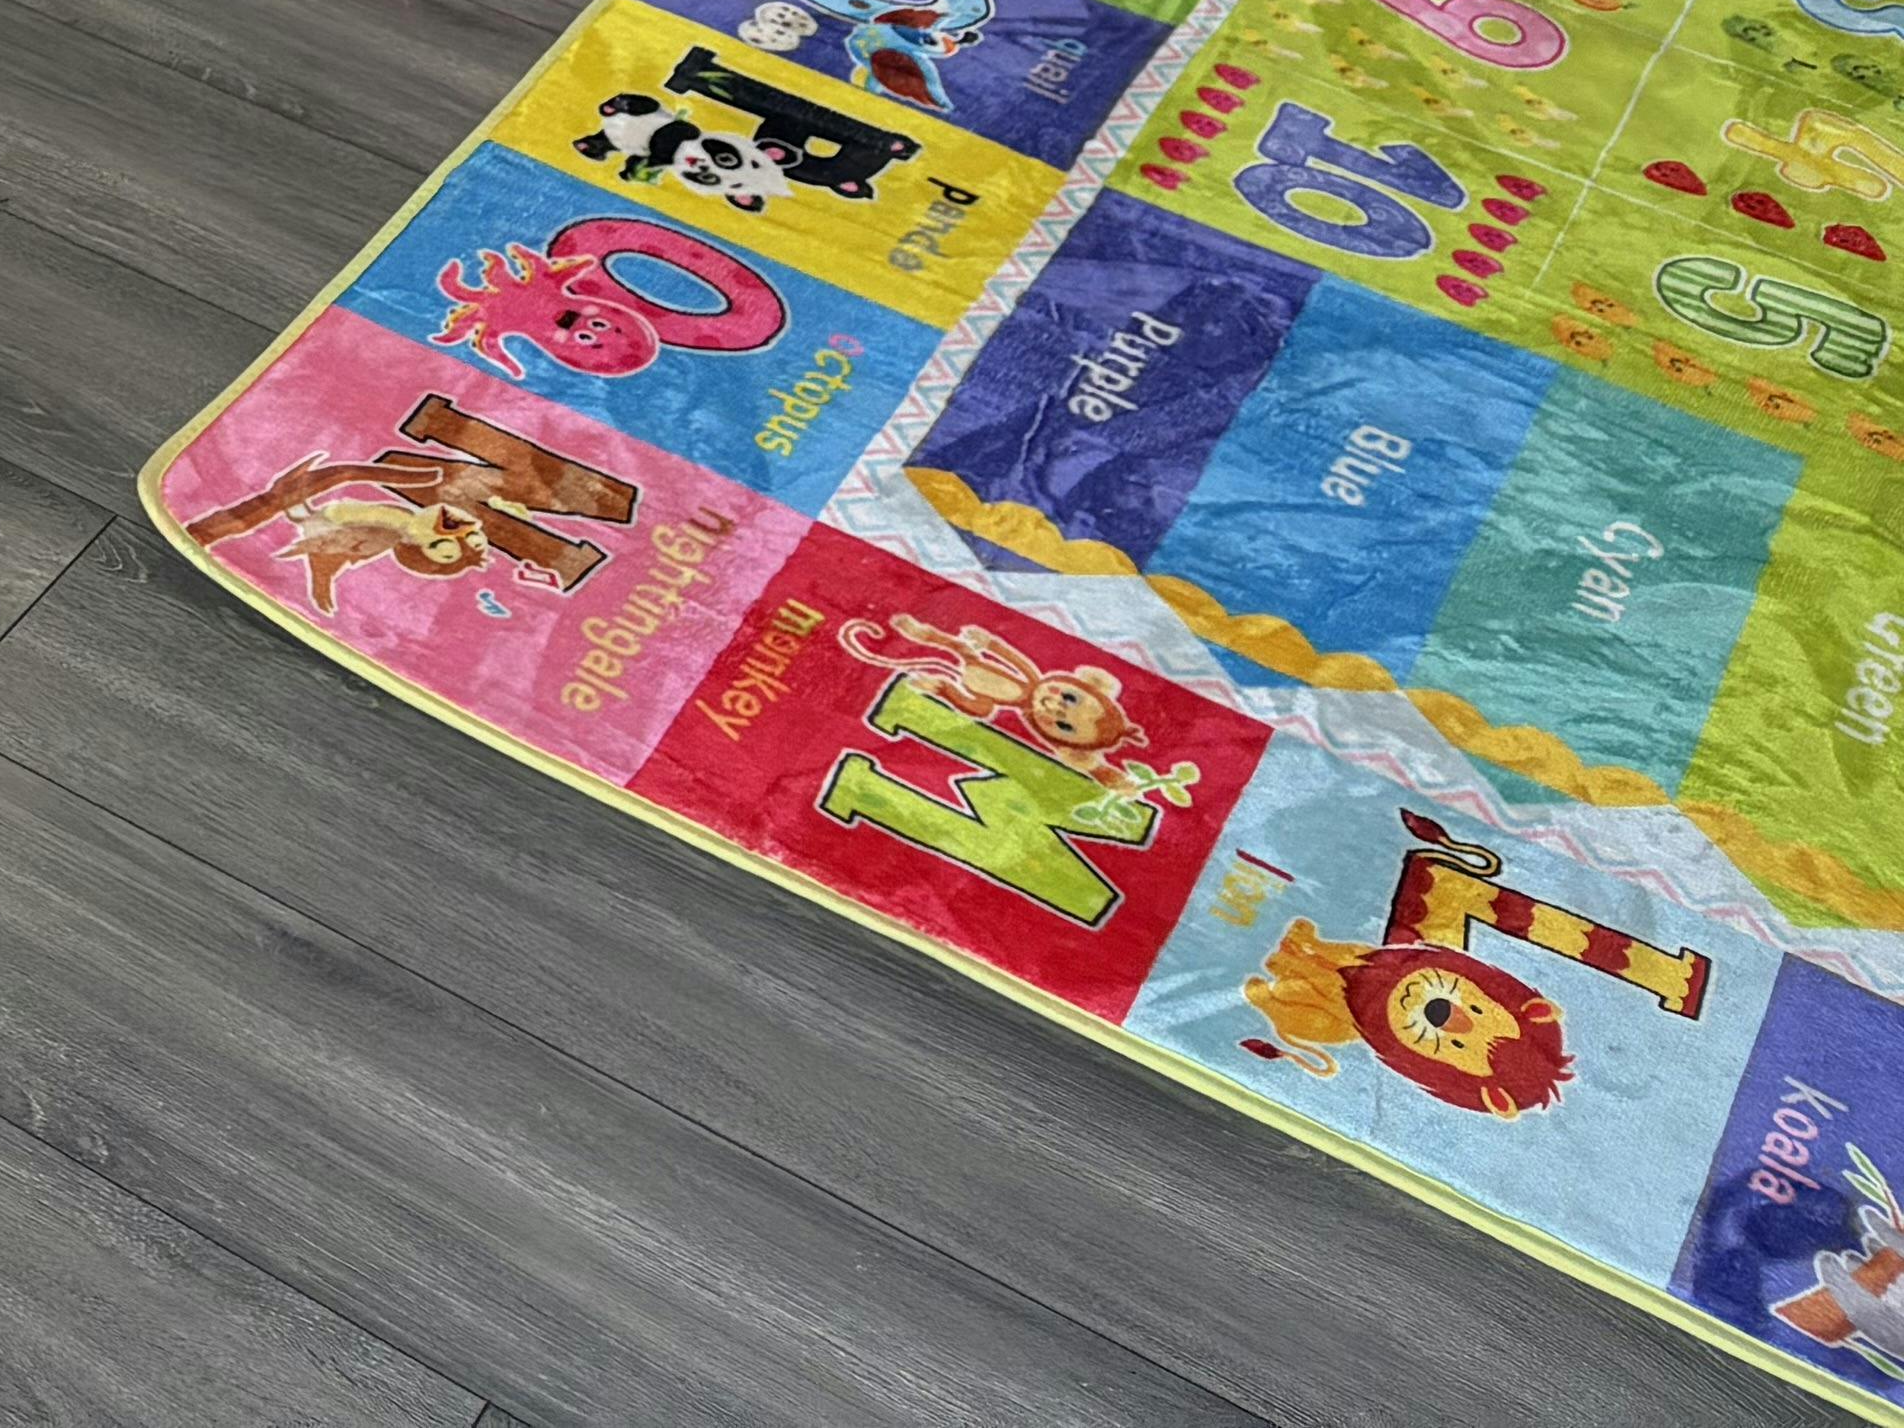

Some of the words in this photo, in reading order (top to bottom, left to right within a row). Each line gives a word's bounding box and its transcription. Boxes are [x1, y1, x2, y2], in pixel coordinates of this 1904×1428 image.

[664, 45, 924, 201] P
[887, 176, 979, 275] panda
[1233, 101, 1468, 260] 10
[544, 214, 787, 354] O
[754, 332, 864, 456] octopus
[1069, 311, 1184, 425] Purple
[1654, 255, 1889, 380] 5
[1320, 422, 1416, 511] Blue
[370, 393, 644, 593] N
[560, 504, 735, 714] nightingale
[1569, 521, 1664, 623] Cyan
[697, 599, 824, 741] monkey
[816, 672, 1162, 929] M
[1384, 847, 1712, 1020] L
[1747, 1074, 1850, 1206] Koala
